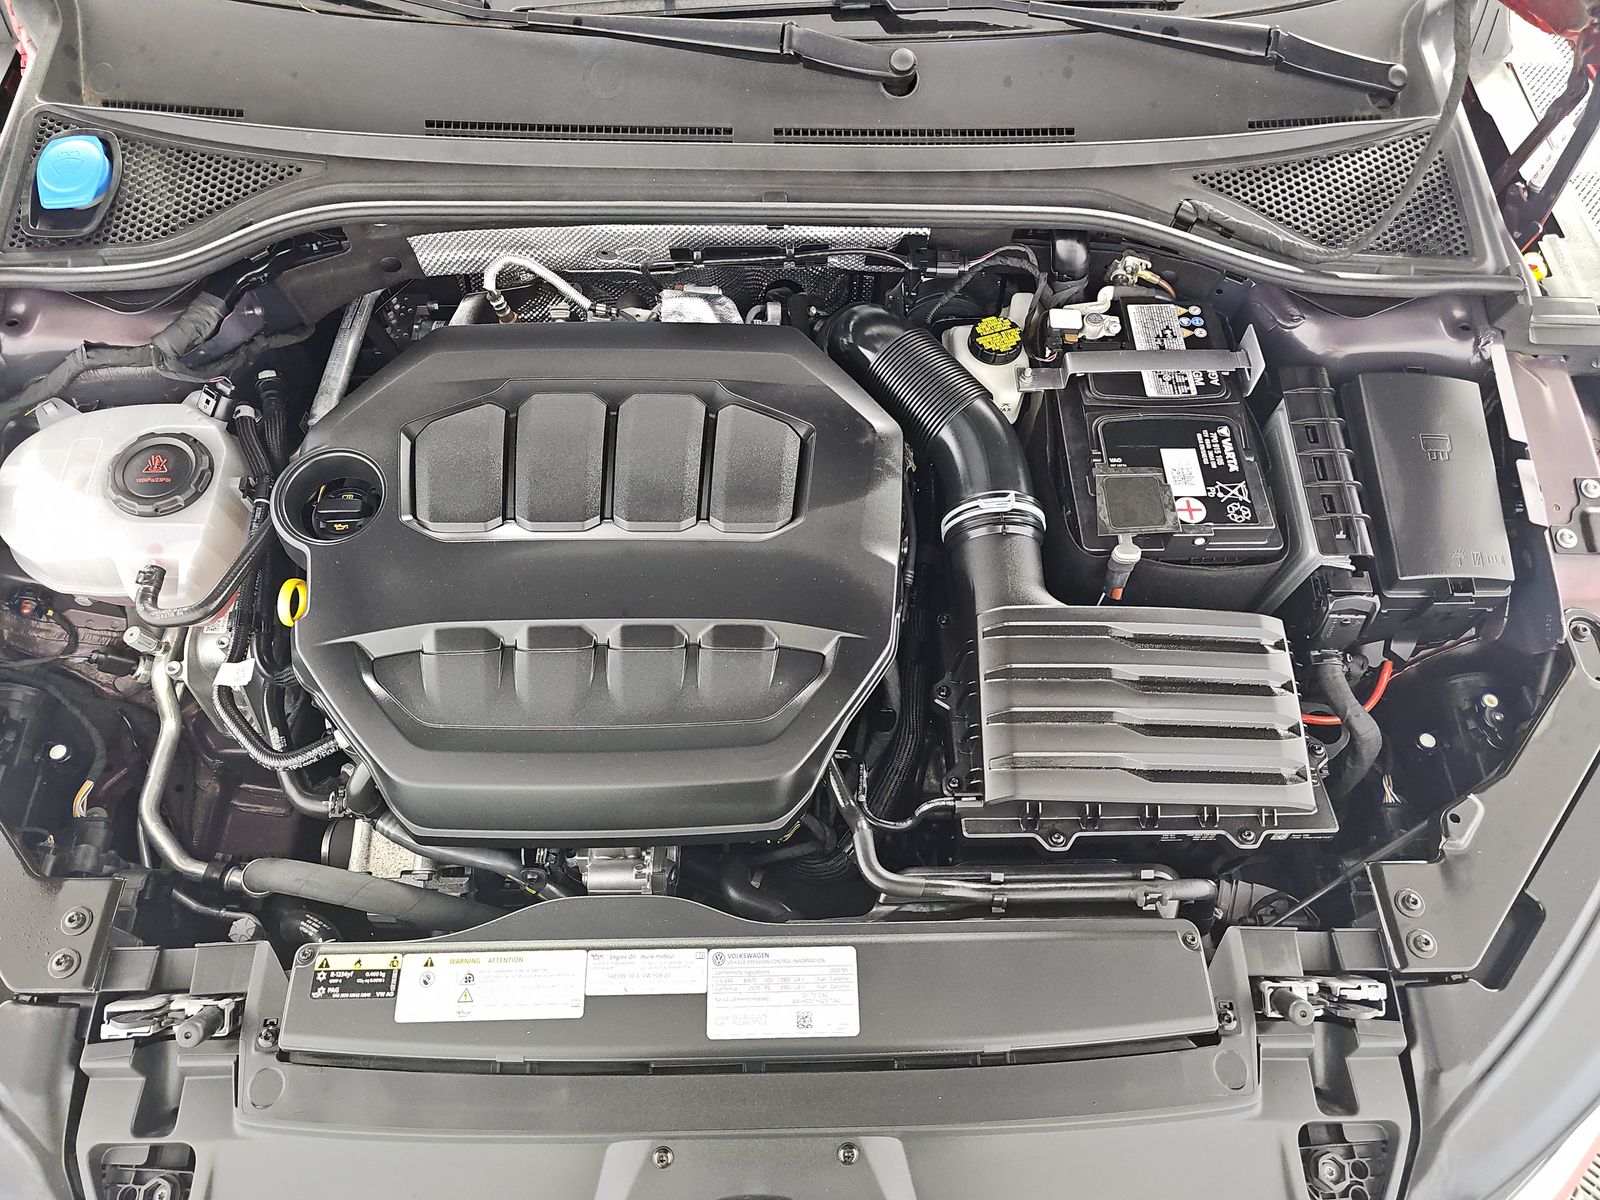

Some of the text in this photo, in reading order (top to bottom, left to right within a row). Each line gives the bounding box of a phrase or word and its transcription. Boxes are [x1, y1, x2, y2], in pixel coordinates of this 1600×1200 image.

[1221, 437, 1240, 473] VARTA
[1206, 486, 1216, 497] Pb
[487, 956, 524, 964] ATTENTION
[727, 952, 770, 960] VOLKSWAGEN
[792, 956, 826, 964] INFORMATION
[330, 971, 354, 979] R-1234yf
